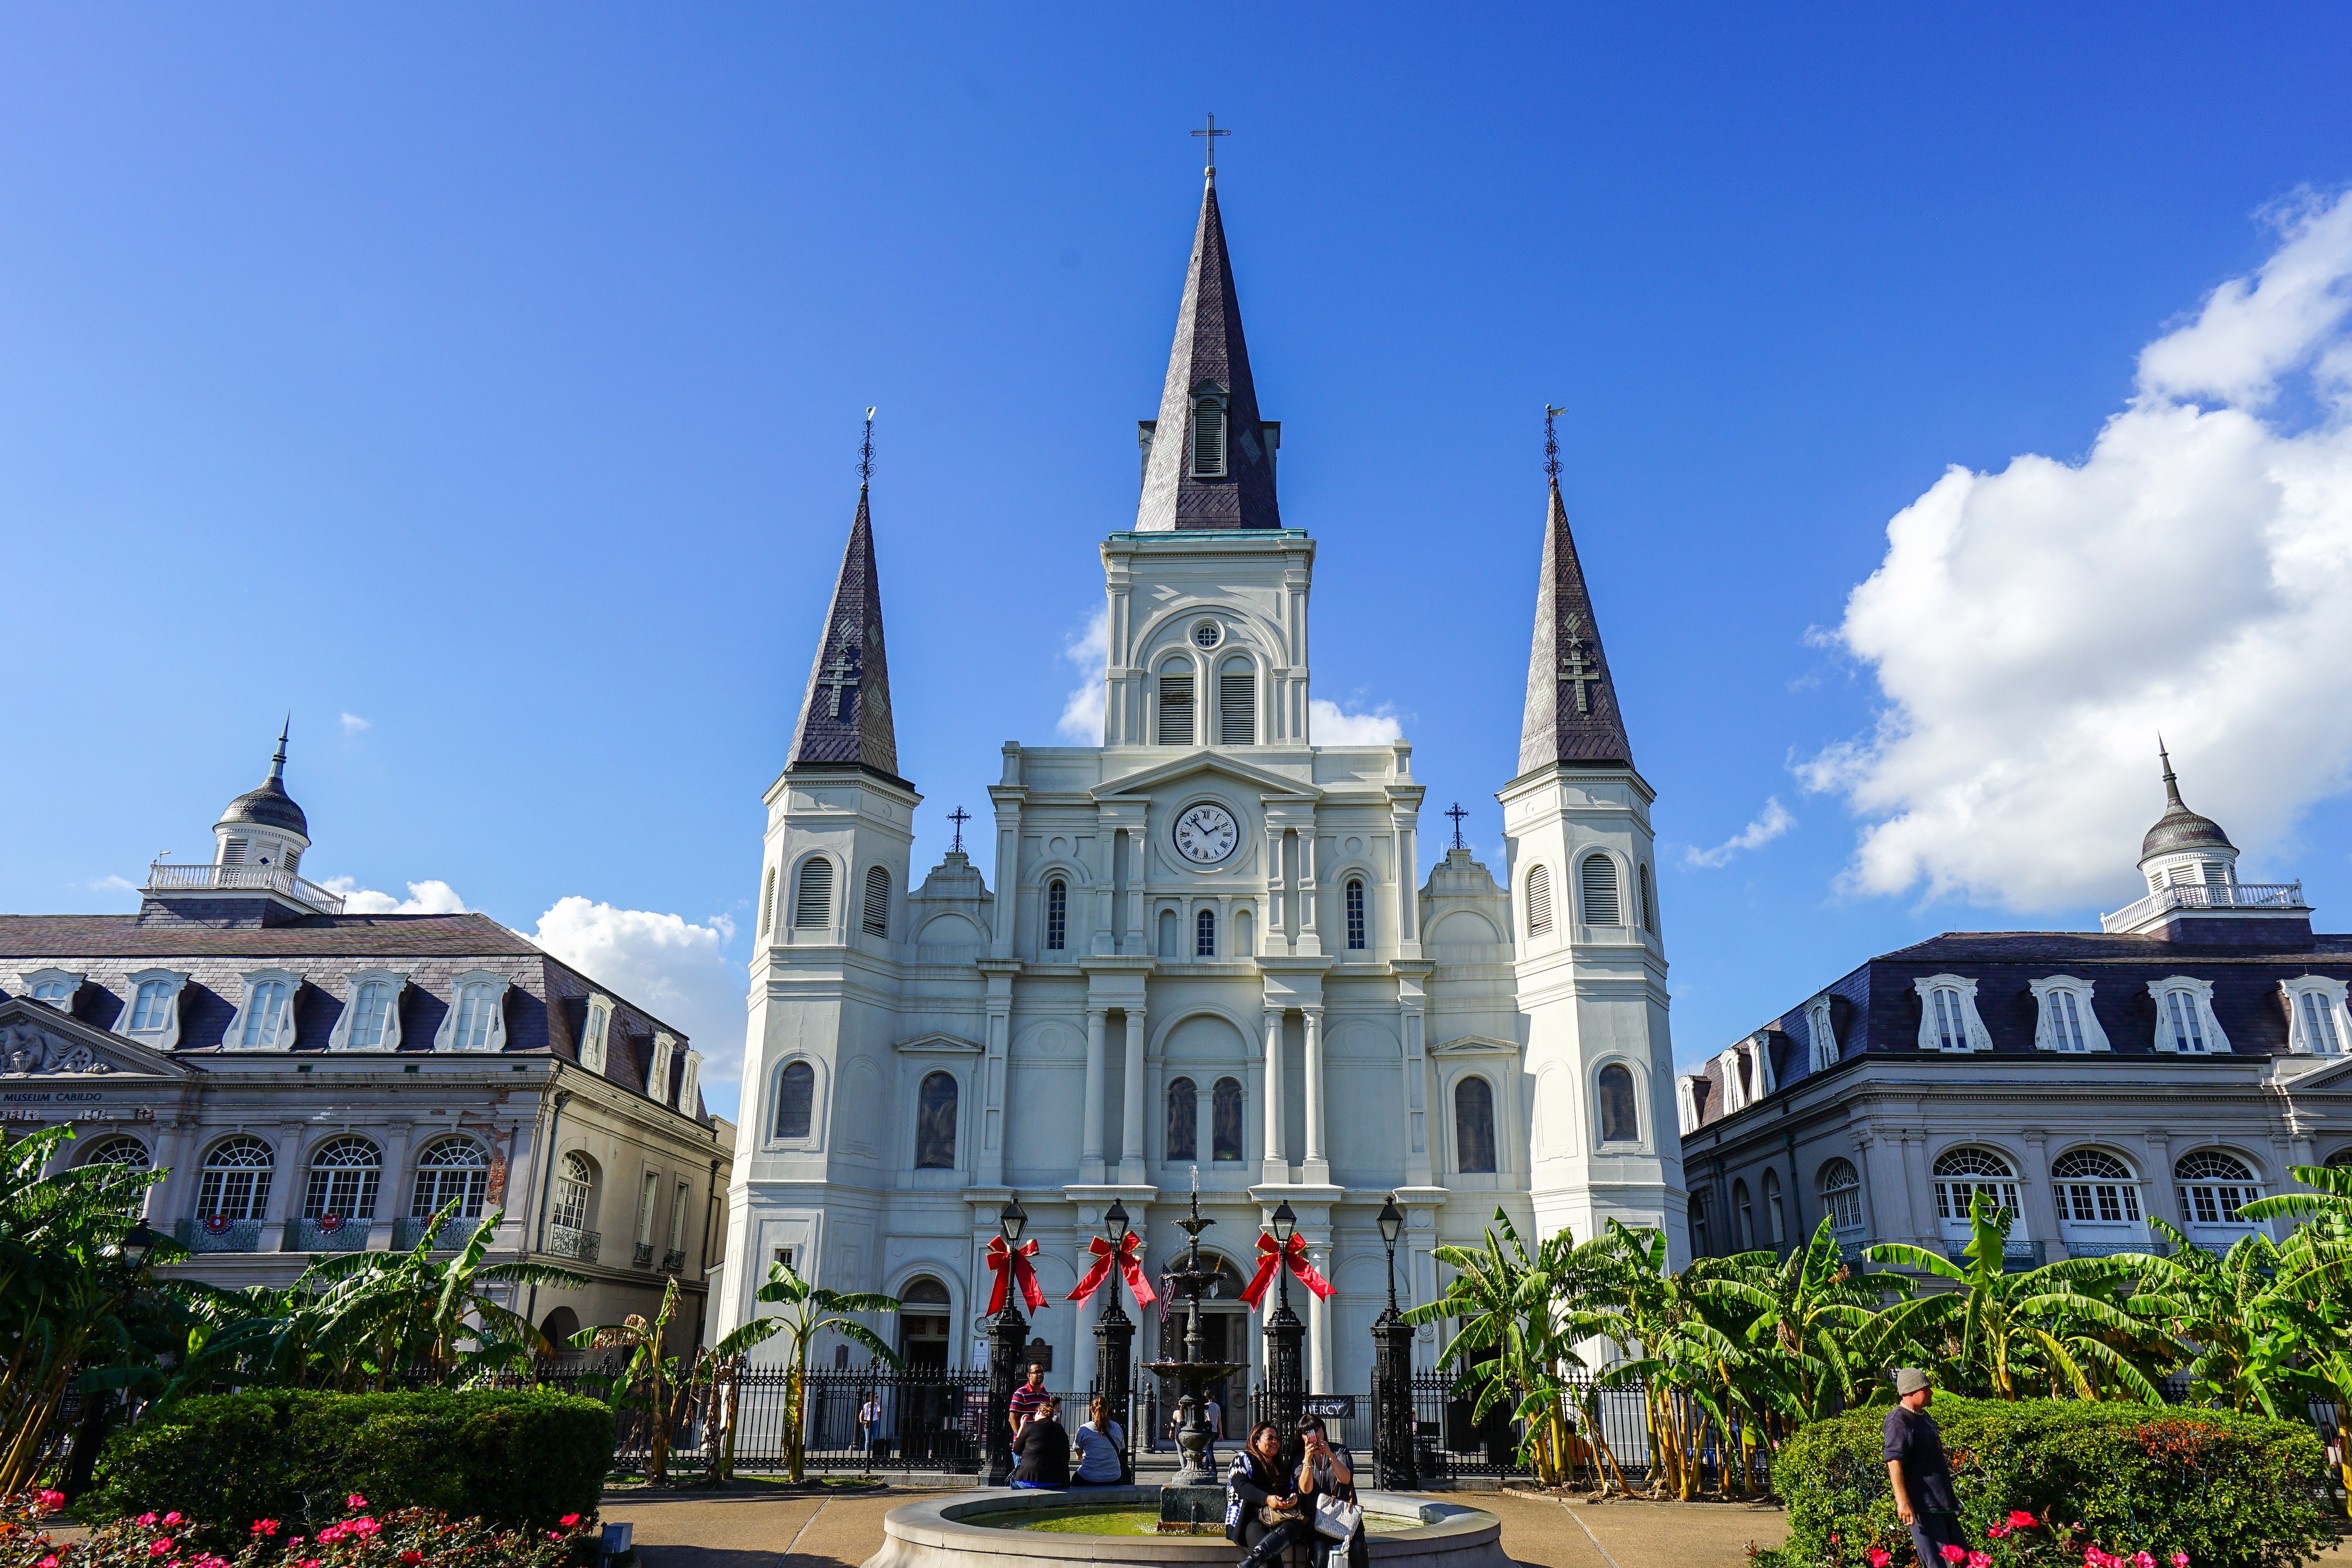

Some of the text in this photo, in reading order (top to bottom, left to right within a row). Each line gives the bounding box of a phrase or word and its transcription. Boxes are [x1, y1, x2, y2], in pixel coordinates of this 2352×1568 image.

[3, 1093, 102, 1102] MUSEUM CABILDO
[1302, 1405, 1342, 1414] MERCY
